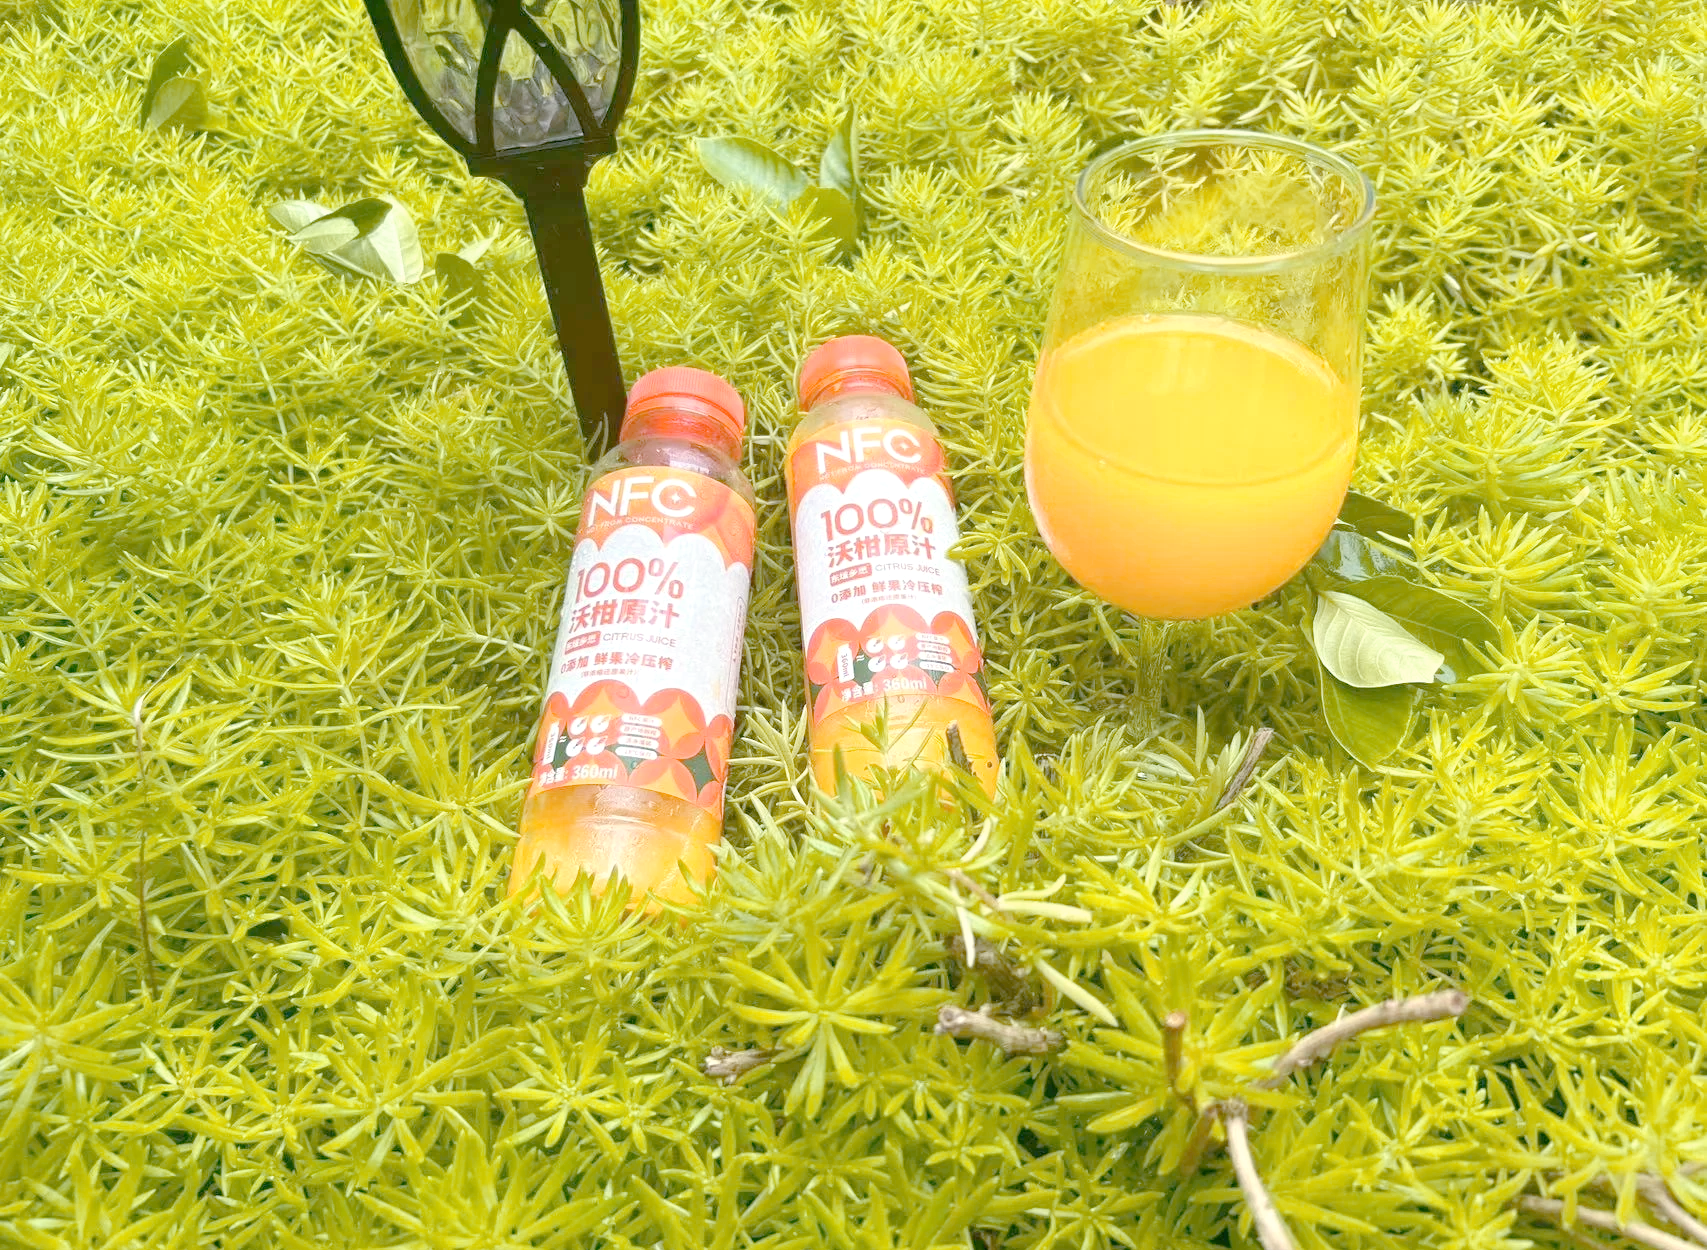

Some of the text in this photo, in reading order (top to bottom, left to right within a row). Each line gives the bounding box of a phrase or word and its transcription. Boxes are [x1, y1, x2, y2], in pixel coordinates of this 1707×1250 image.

[816, 427, 922, 474] NFC
[588, 476, 697, 527] NFC
[600, 517, 623, 528] FROM
[625, 516, 694, 530] CONCENTRATE
[820, 498, 935, 543] 100%
[826, 533, 937, 568] 沃柑原汁
[574, 557, 685, 604] 100%
[874, 562, 941, 576] CITRUS JUICE
[830, 579, 944, 604] 0添加 鲜果冷压榨
[568, 598, 680, 634] 沃柑原汁
[602, 632, 677, 648] CITRUS JUICE
[560, 651, 674, 674] 0添加 鲜果冷压榨
[882, 676, 928, 692] 360ml
[572, 764, 618, 782] 360ml
